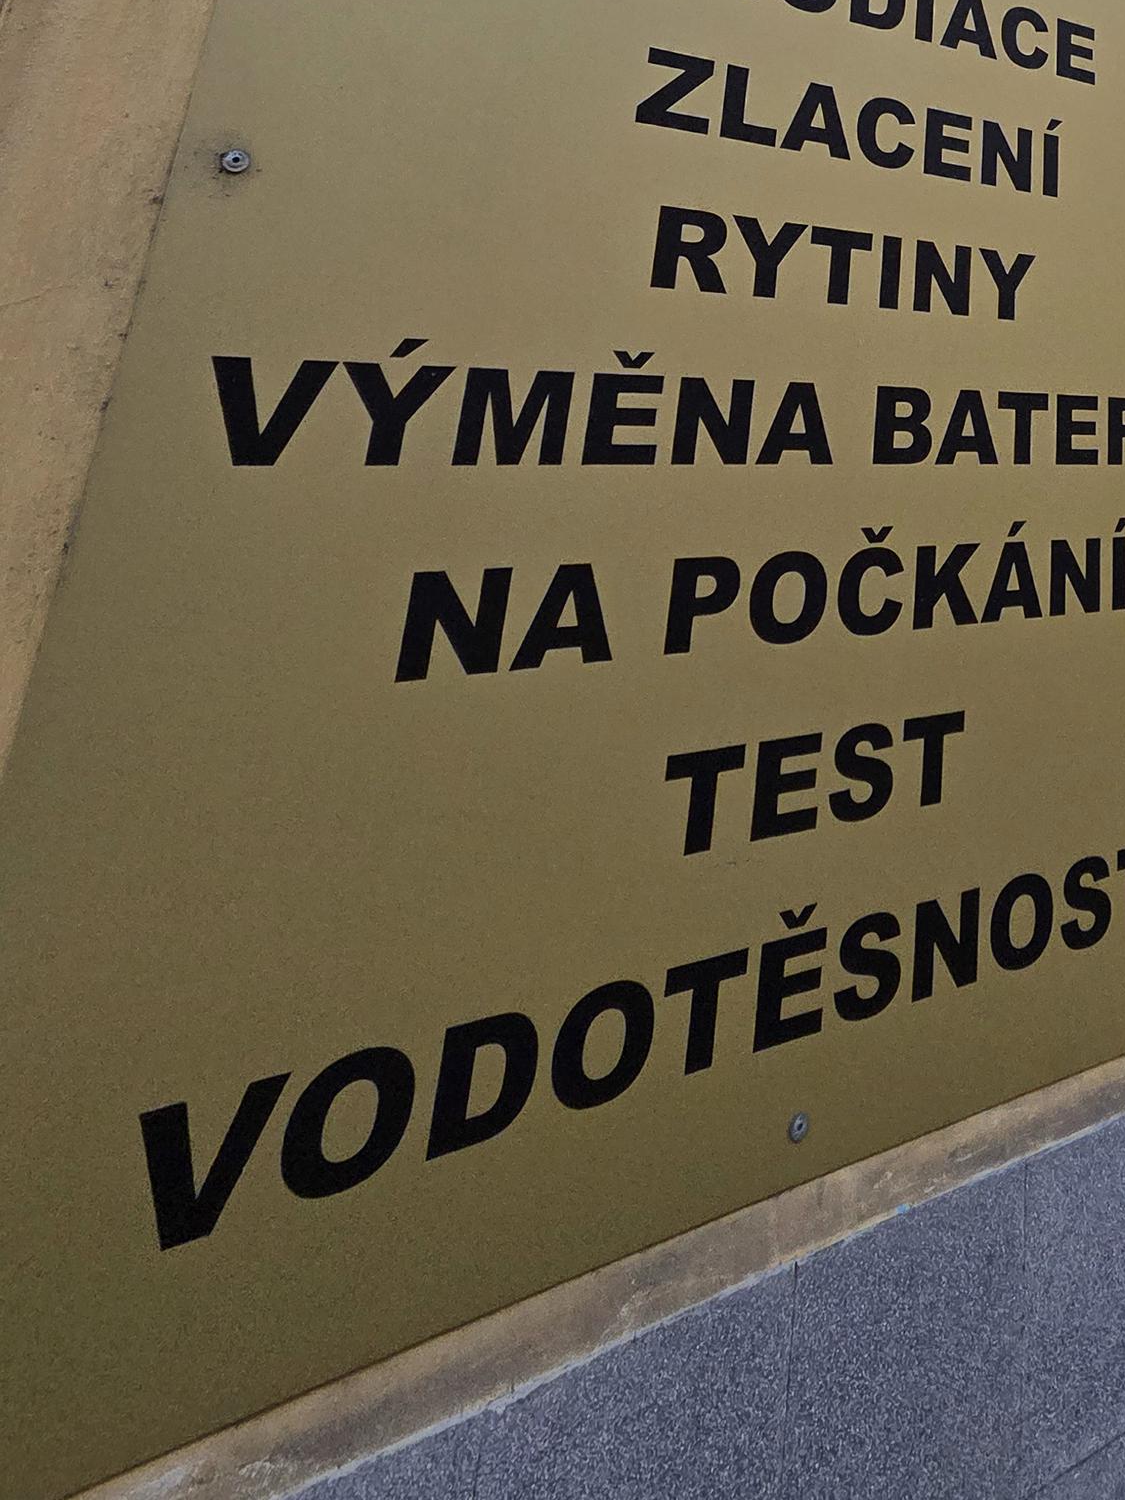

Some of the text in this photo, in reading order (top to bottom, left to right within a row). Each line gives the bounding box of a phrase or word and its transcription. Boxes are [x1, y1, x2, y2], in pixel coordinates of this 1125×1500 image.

[635, 46, 1061, 198] ZLACENÍ
[650, 204, 1036, 321] RYTINY
[211, 338, 834, 468] VÝMĚNA
[393, 562, 613, 684] NA
[664, 710, 966, 857] TEST
